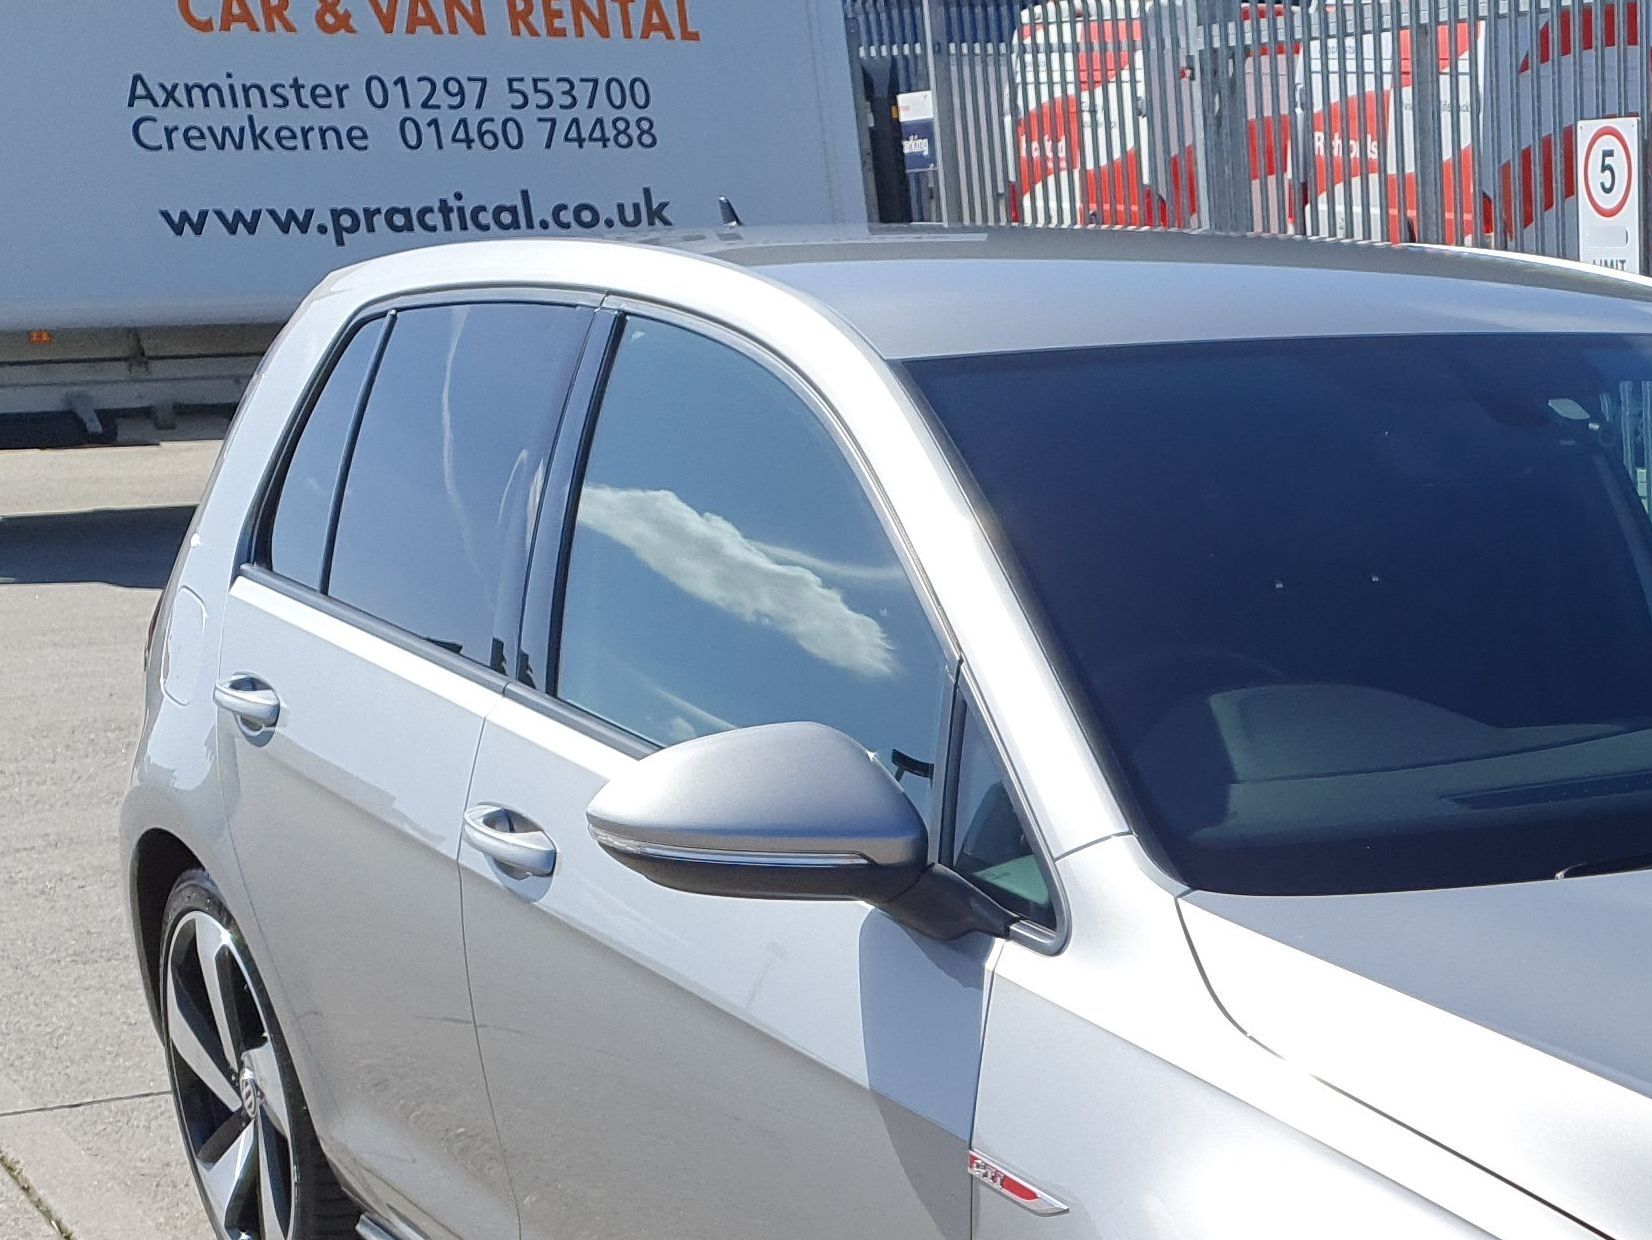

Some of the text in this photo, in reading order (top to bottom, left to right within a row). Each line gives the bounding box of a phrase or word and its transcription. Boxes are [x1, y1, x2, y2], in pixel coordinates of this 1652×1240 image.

[178, 0, 701, 42] CAR & VAN RENTAL
[127, 71, 652, 110] Axminster 01297 553700
[131, 113, 658, 151] Crewkerne 01460 74488
[1600, 149, 1616, 195] 5
[158, 186, 673, 248] www.practical.co.uk
